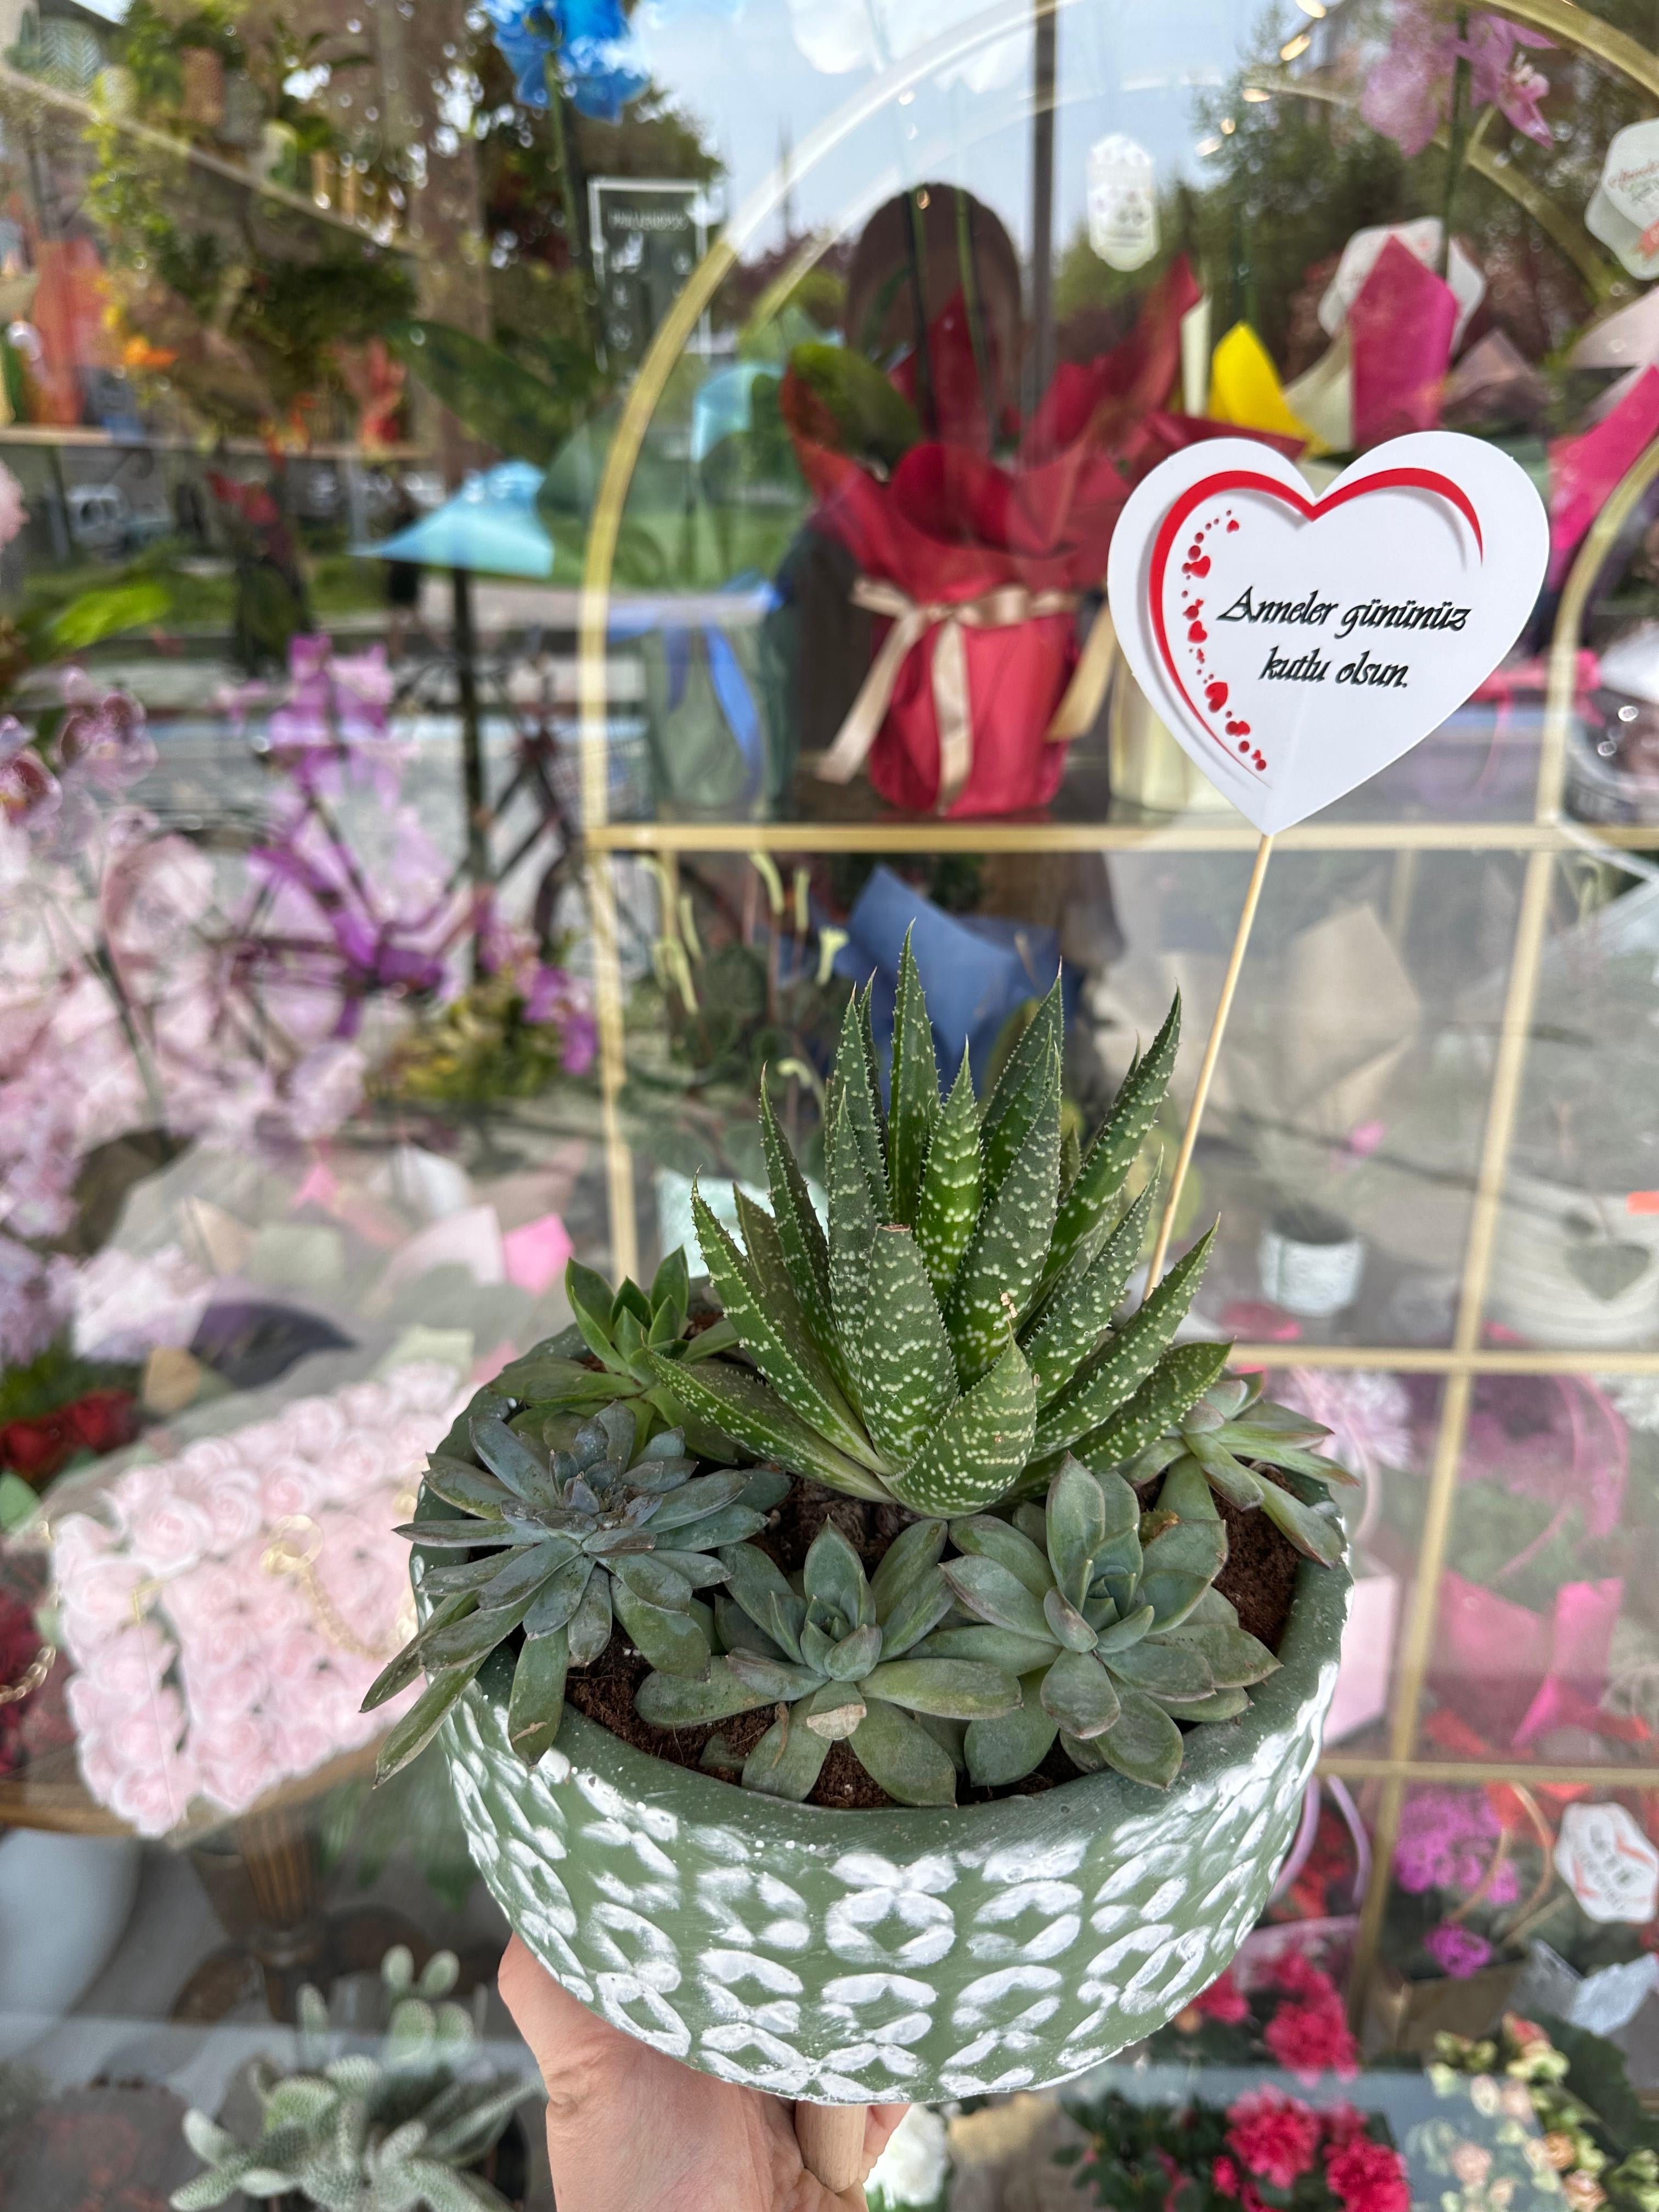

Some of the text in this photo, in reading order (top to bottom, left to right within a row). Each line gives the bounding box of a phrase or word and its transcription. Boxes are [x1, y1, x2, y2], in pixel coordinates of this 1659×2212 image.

[1217, 585, 1472, 639] Anneler gününüz
[1259, 645, 1409, 689] kutlu olsun.
